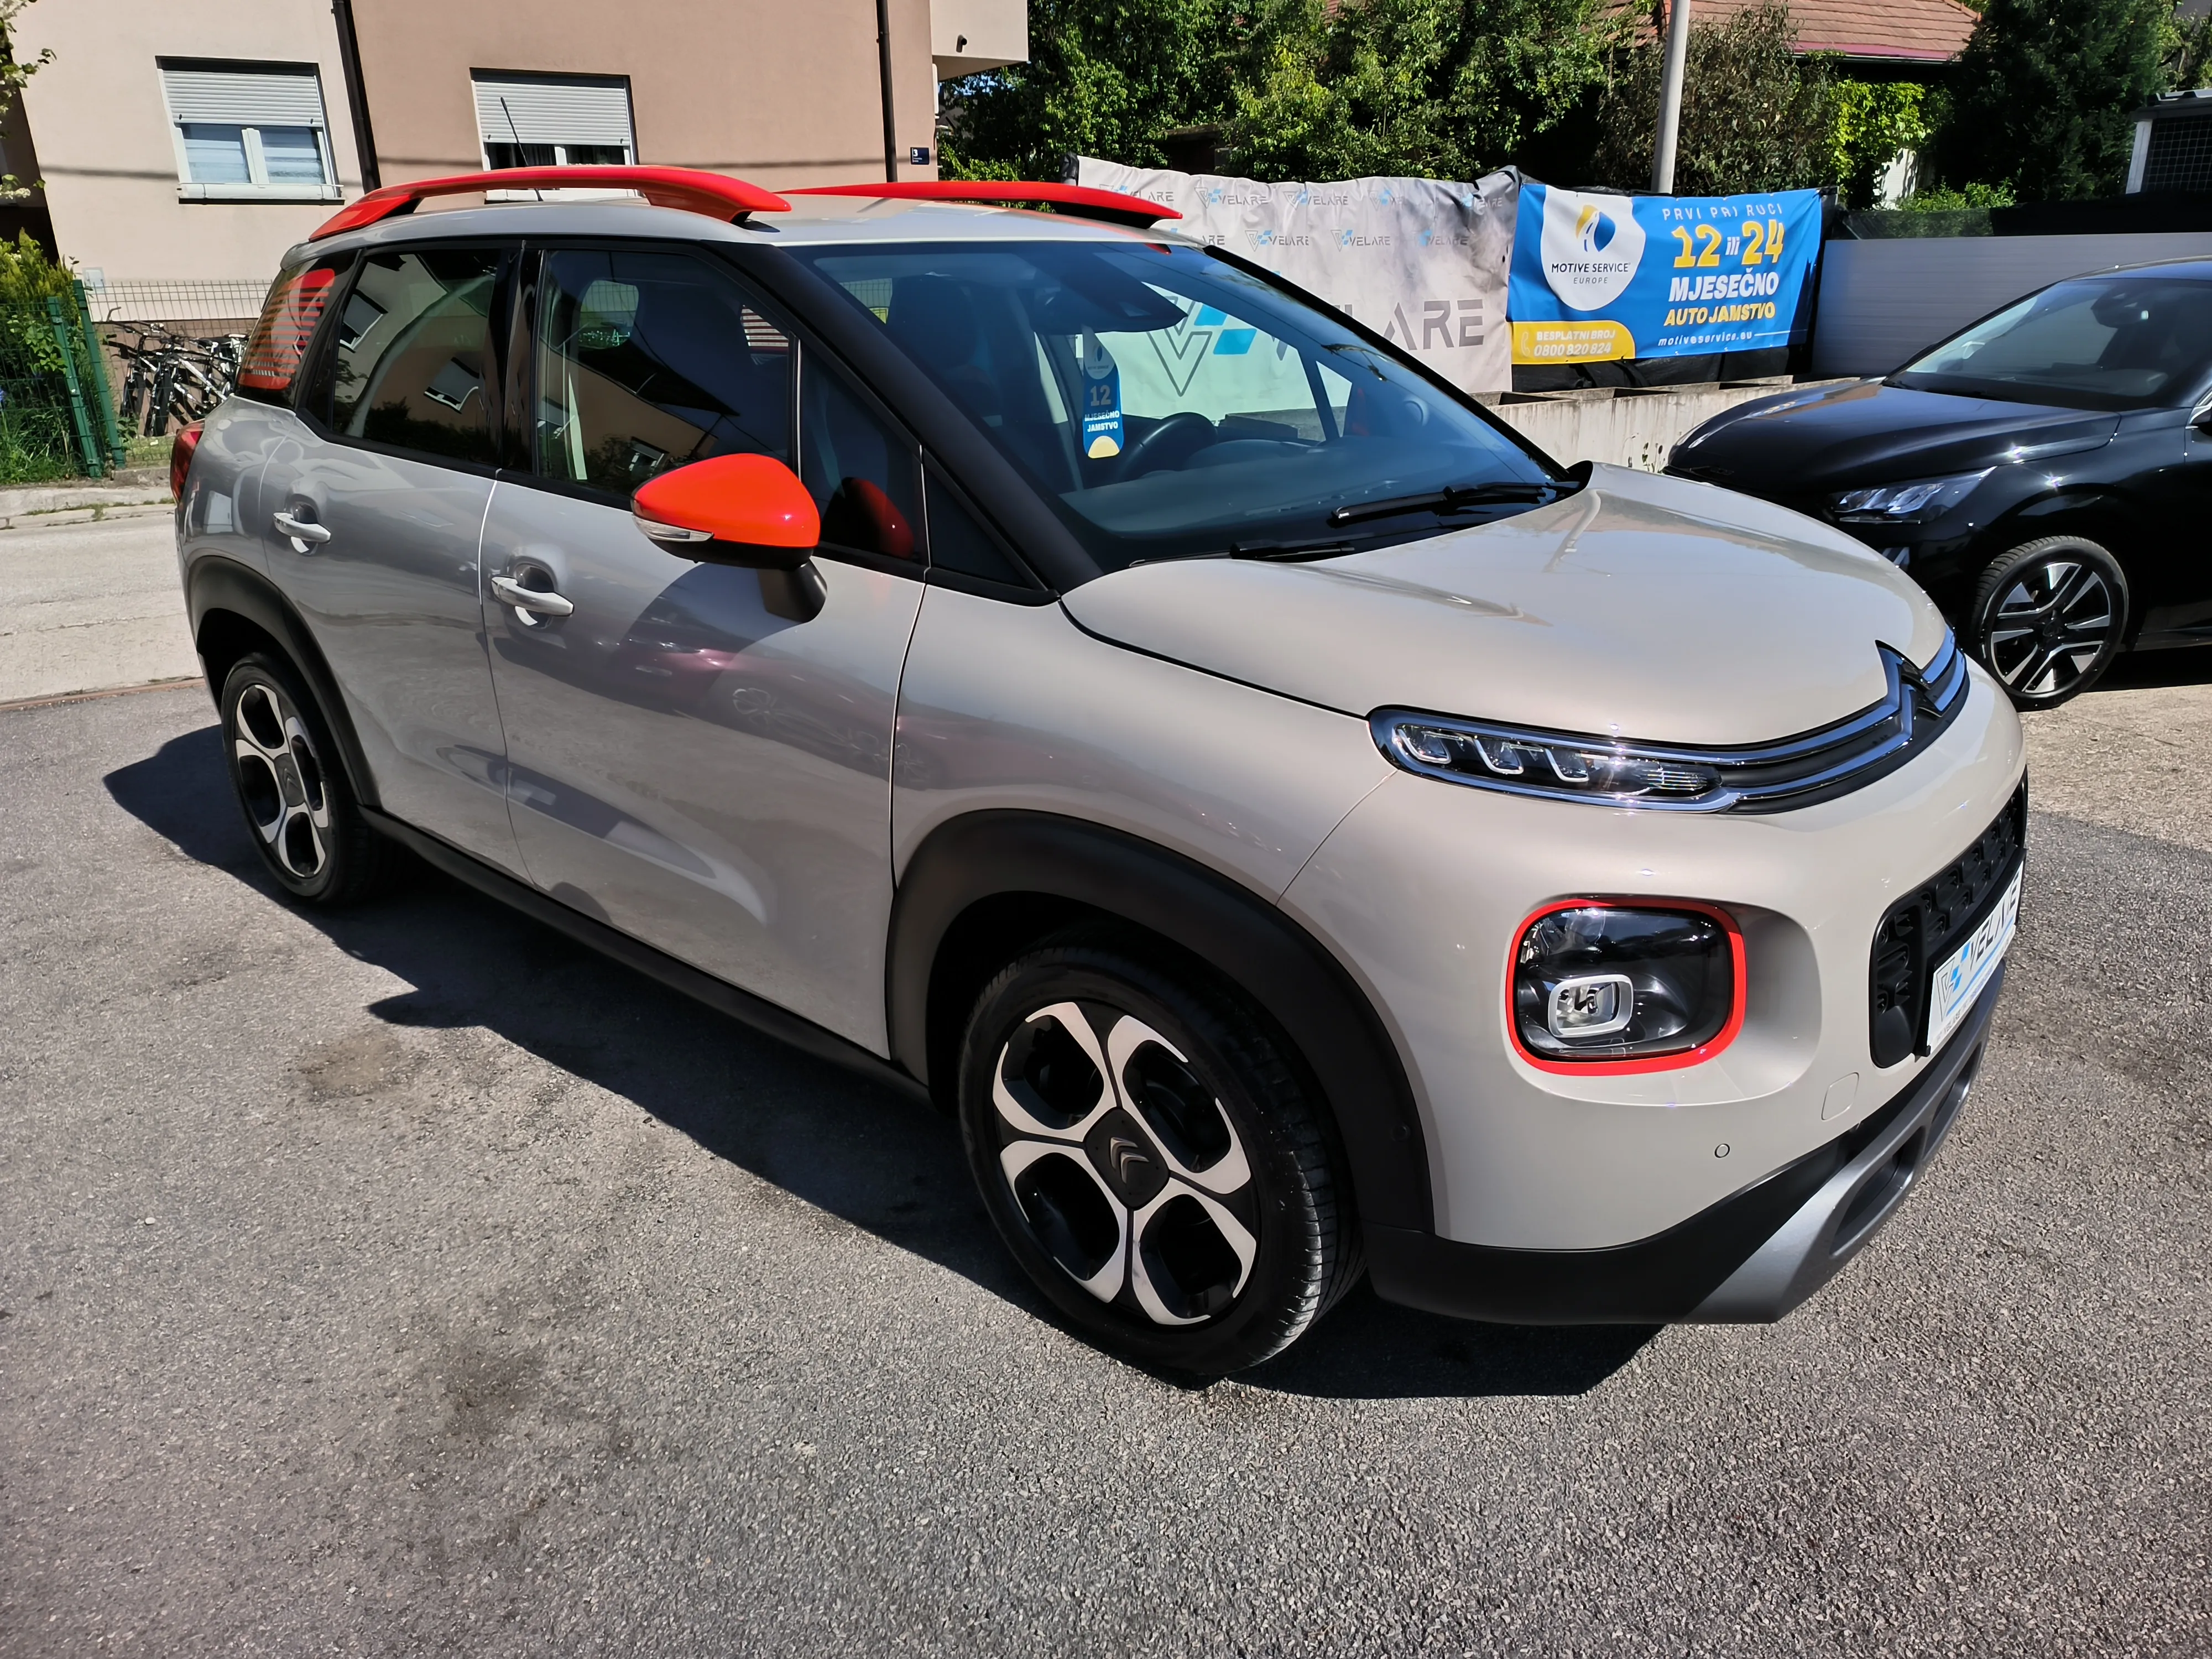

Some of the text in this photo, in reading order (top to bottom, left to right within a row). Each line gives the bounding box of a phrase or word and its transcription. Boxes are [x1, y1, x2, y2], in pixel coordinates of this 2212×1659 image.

[913, 149, 919, 157] 3
[1219, 195, 1269, 205] VELARE
[1662, 207, 1702, 221] PRVI
[1746, 203, 1782, 216] RUCI
[1350, 236, 1391, 246] VELARE
[1671, 219, 1785, 268] 12 ili 24
[1551, 262, 1629, 273] MOTIVE SERVICE
[1573, 276, 1608, 285] EUROPE
[1668, 267, 1780, 302] MJESEČNO
[1663, 301, 1776, 327] AUTO JAMSTVO
[1536, 329, 1616, 341] BESPLATNI BROJ
[1657, 331, 1752, 347] motiveservice.eu
[1533, 342, 1613, 357] 0800 820 824
[1090, 385, 1111, 406] 12
[1084, 410, 1120, 421] MJESEČNO
[1087, 421, 1118, 432] JAMSTVO
